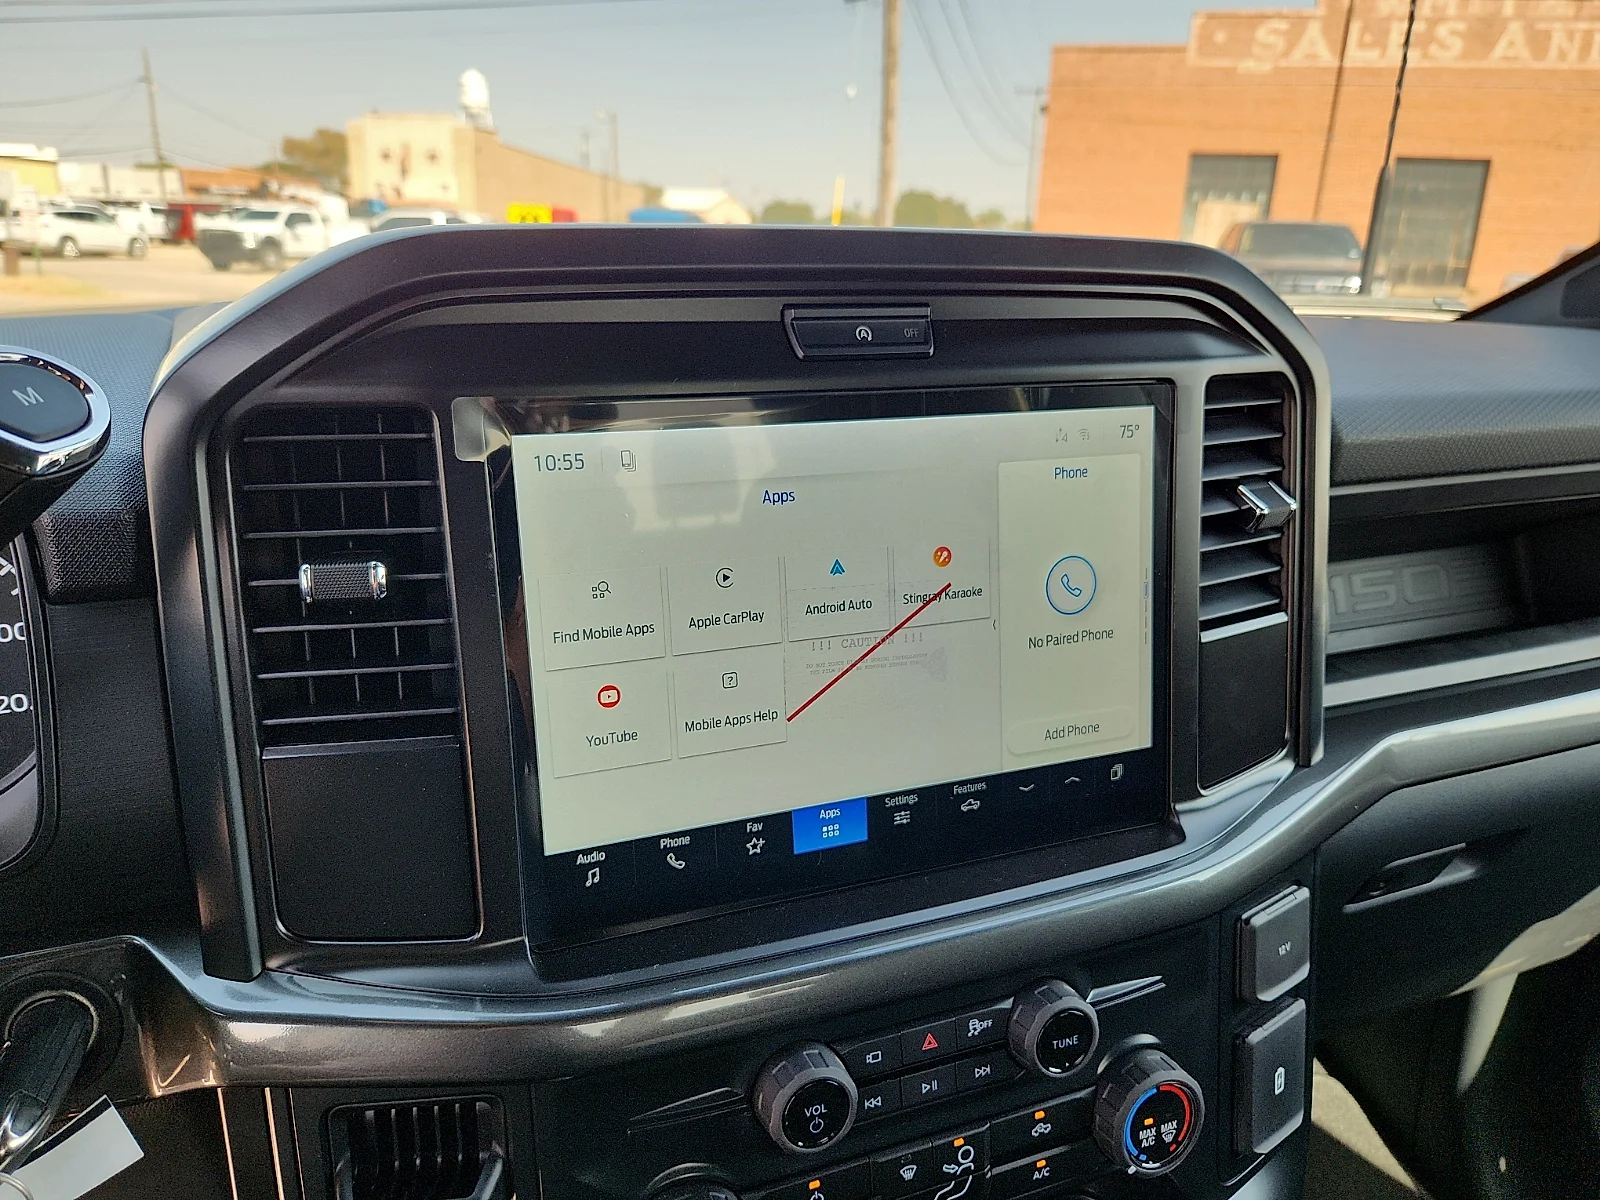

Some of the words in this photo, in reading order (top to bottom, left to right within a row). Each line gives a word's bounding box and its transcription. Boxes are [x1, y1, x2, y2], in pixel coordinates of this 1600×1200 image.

[1251, 18, 1467, 61] SALES
[904, 328, 918, 338] OFF
[11, 386, 45, 406] M
[534, 453, 585, 472] 10:55
[1054, 466, 1088, 480] Phone
[762, 490, 796, 506] Apps
[944, 586, 983, 600] Karaoke
[1329, 563, 1450, 615] 150
[805, 602, 846, 616] Android
[847, 599, 873, 610] Auto
[688, 613, 721, 629] Apple
[723, 610, 765, 625] CarPlay
[553, 629, 580, 644] Find
[582, 626, 623, 641] Mobile
[625, 622, 656, 637] Apps
[1028, 636, 1044, 649] No
[1046, 630, 1079, 647] Paired
[1081, 628, 1114, 642] Phone
[685, 718, 722, 733] Mobile
[724, 714, 752, 728] Apps
[753, 709, 778, 724] Help
[586, 729, 638, 748] YouTube
[1044, 725, 1065, 741] Add
[1067, 723, 1100, 737] Phone
[953, 782, 987, 795] Features
[885, 794, 918, 808] Settings
[819, 807, 841, 819] Apps
[746, 822, 763, 833] Fav
[660, 834, 690, 849] Phone
[576, 850, 606, 865] Audio
[979, 1019, 993, 1029] OFF
[1052, 1035, 1079, 1050] TUNE
[804, 1105, 828, 1117] VOL
[1139, 1127, 1157, 1140] MAX
[1160, 1119, 1178, 1133] MAX
[1141, 1136, 1155, 1148] A/C
[1033, 1166, 1050, 1180] A/C
